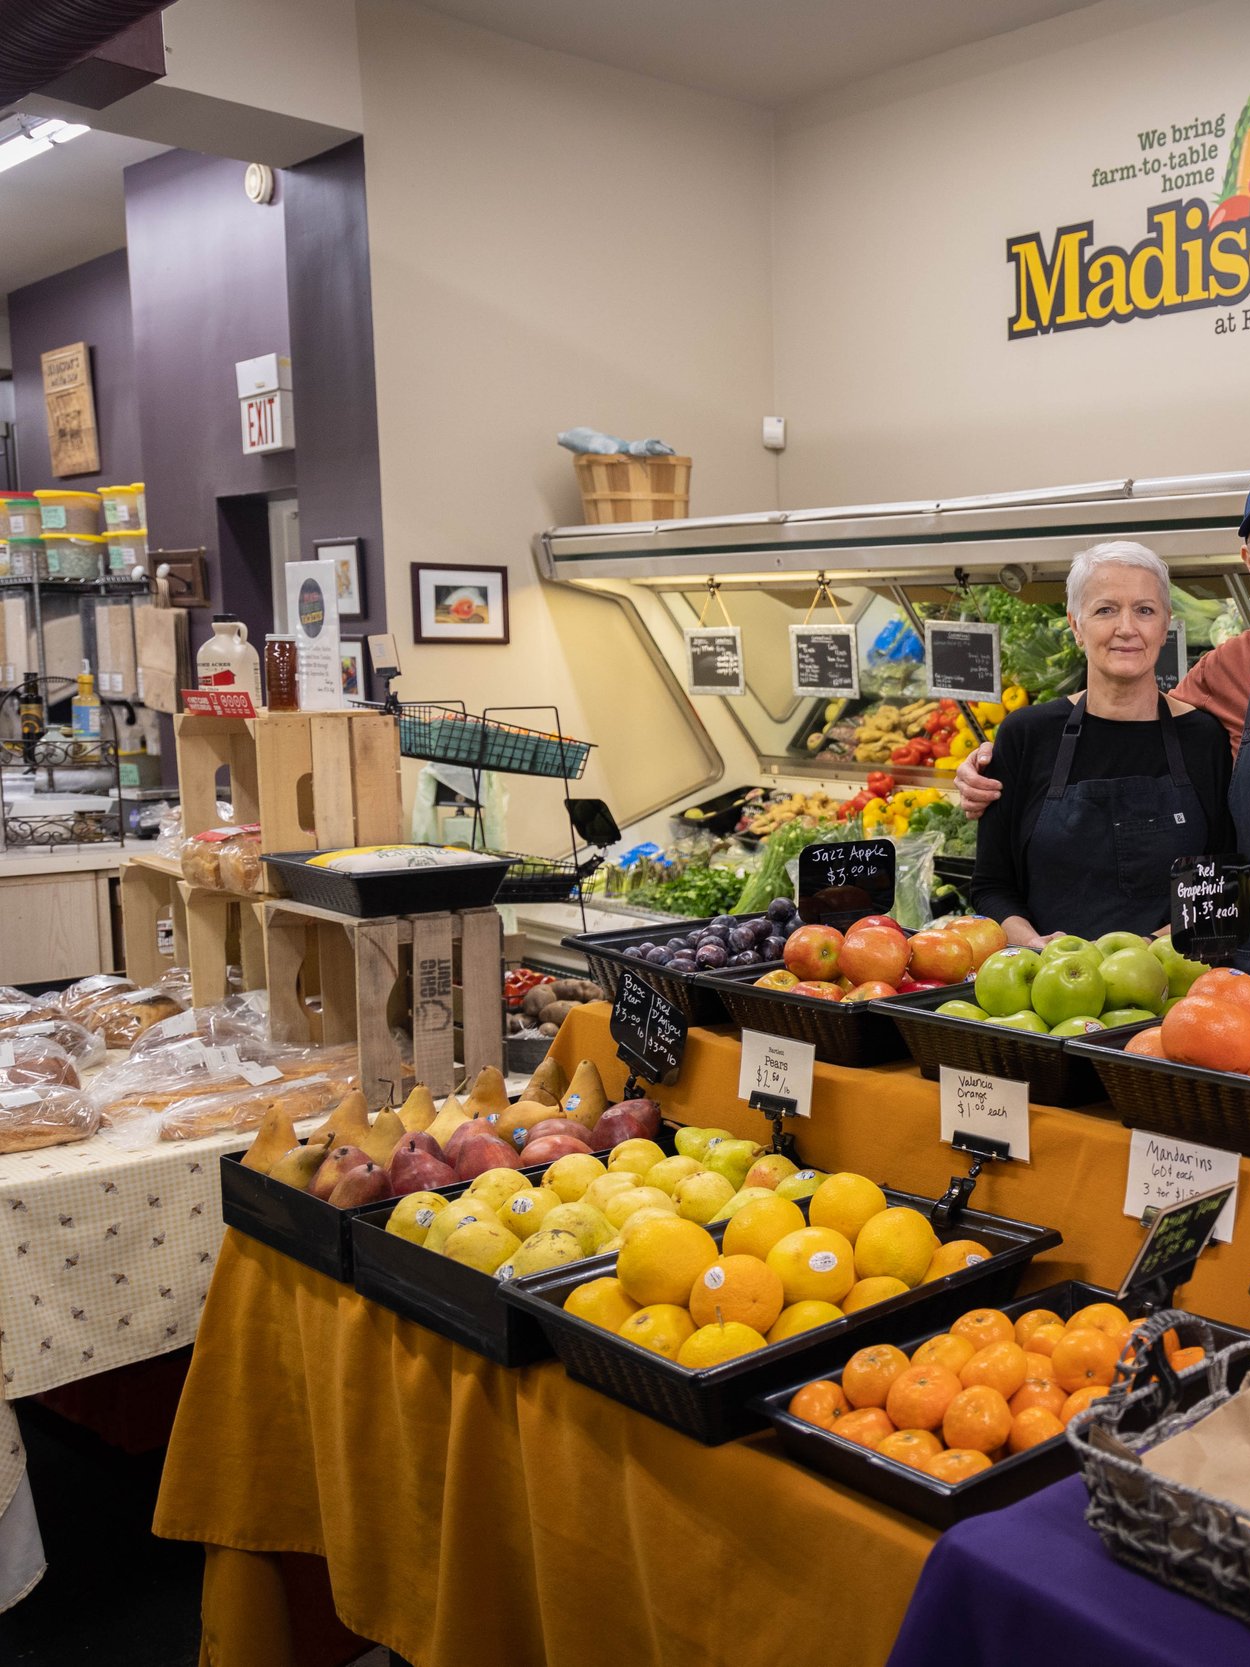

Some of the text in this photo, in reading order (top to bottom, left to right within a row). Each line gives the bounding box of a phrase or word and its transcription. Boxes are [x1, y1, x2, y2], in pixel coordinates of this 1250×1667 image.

[1138, 114, 1226, 152] We bring
[1092, 144, 1219, 188] farm-to-table
[1161, 166, 1216, 193] home
[1214, 311, 1236, 335] at
[248, 398, 275, 447] EXIT
[812, 845, 889, 862] Jazz Apple
[867, 866, 878, 876] lb
[1197, 862, 1215, 877] Red
[1177, 876, 1225, 902] Grapefruit
[1182, 901, 1239, 929] $1.35 each
[624, 973, 646, 999] Bosc
[623, 989, 641, 1005] Pear
[656, 997, 671, 1016] Red
[657, 1027, 675, 1045] Pear
[667, 1053, 677, 1066] lb
[764, 1055, 789, 1071] Pears
[958, 1076, 993, 1090] Valencia
[957, 1088, 987, 1104] Orange
[957, 1101, 1008, 1118] $1.00 each
[1146, 1140, 1213, 1172] Mandarins
[1151, 1163, 1194, 1181] 60¢ each
[1143, 1182, 1150, 1196] 3
[1156, 1187, 1170, 1198] for
